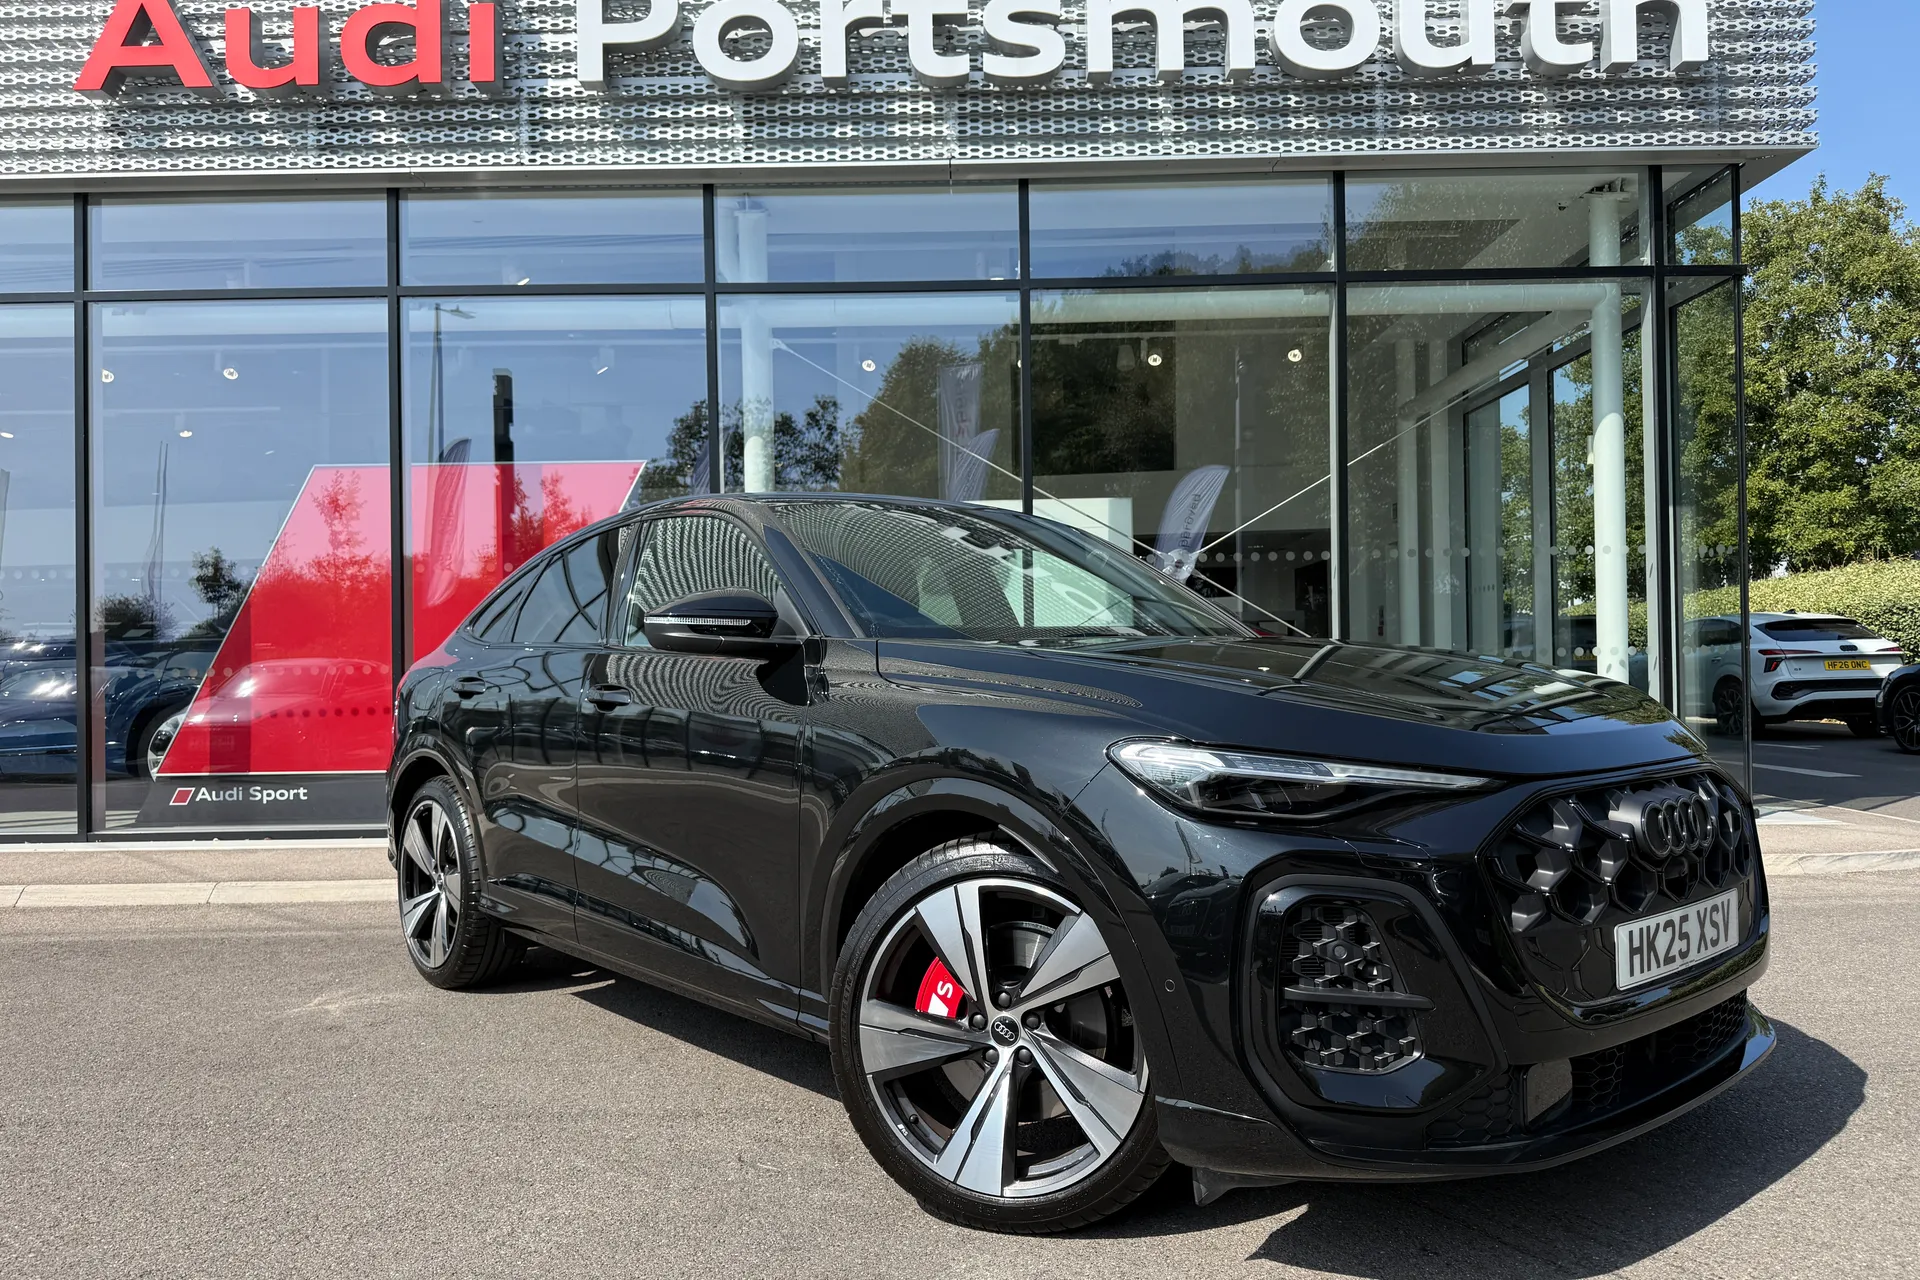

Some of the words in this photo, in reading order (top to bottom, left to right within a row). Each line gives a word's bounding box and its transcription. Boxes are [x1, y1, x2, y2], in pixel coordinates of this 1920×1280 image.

[73, 0, 495, 89] Audi
[577, 0, 1708, 86] Portsmouth
[1179, 493, 1202, 551] pproved
[1827, 661, 1849, 669] HF26
[195, 786, 243, 802] Audi
[249, 786, 308, 804] Sport
[1628, 913, 1691, 978] HK25
[1696, 898, 1731, 954] XSV
